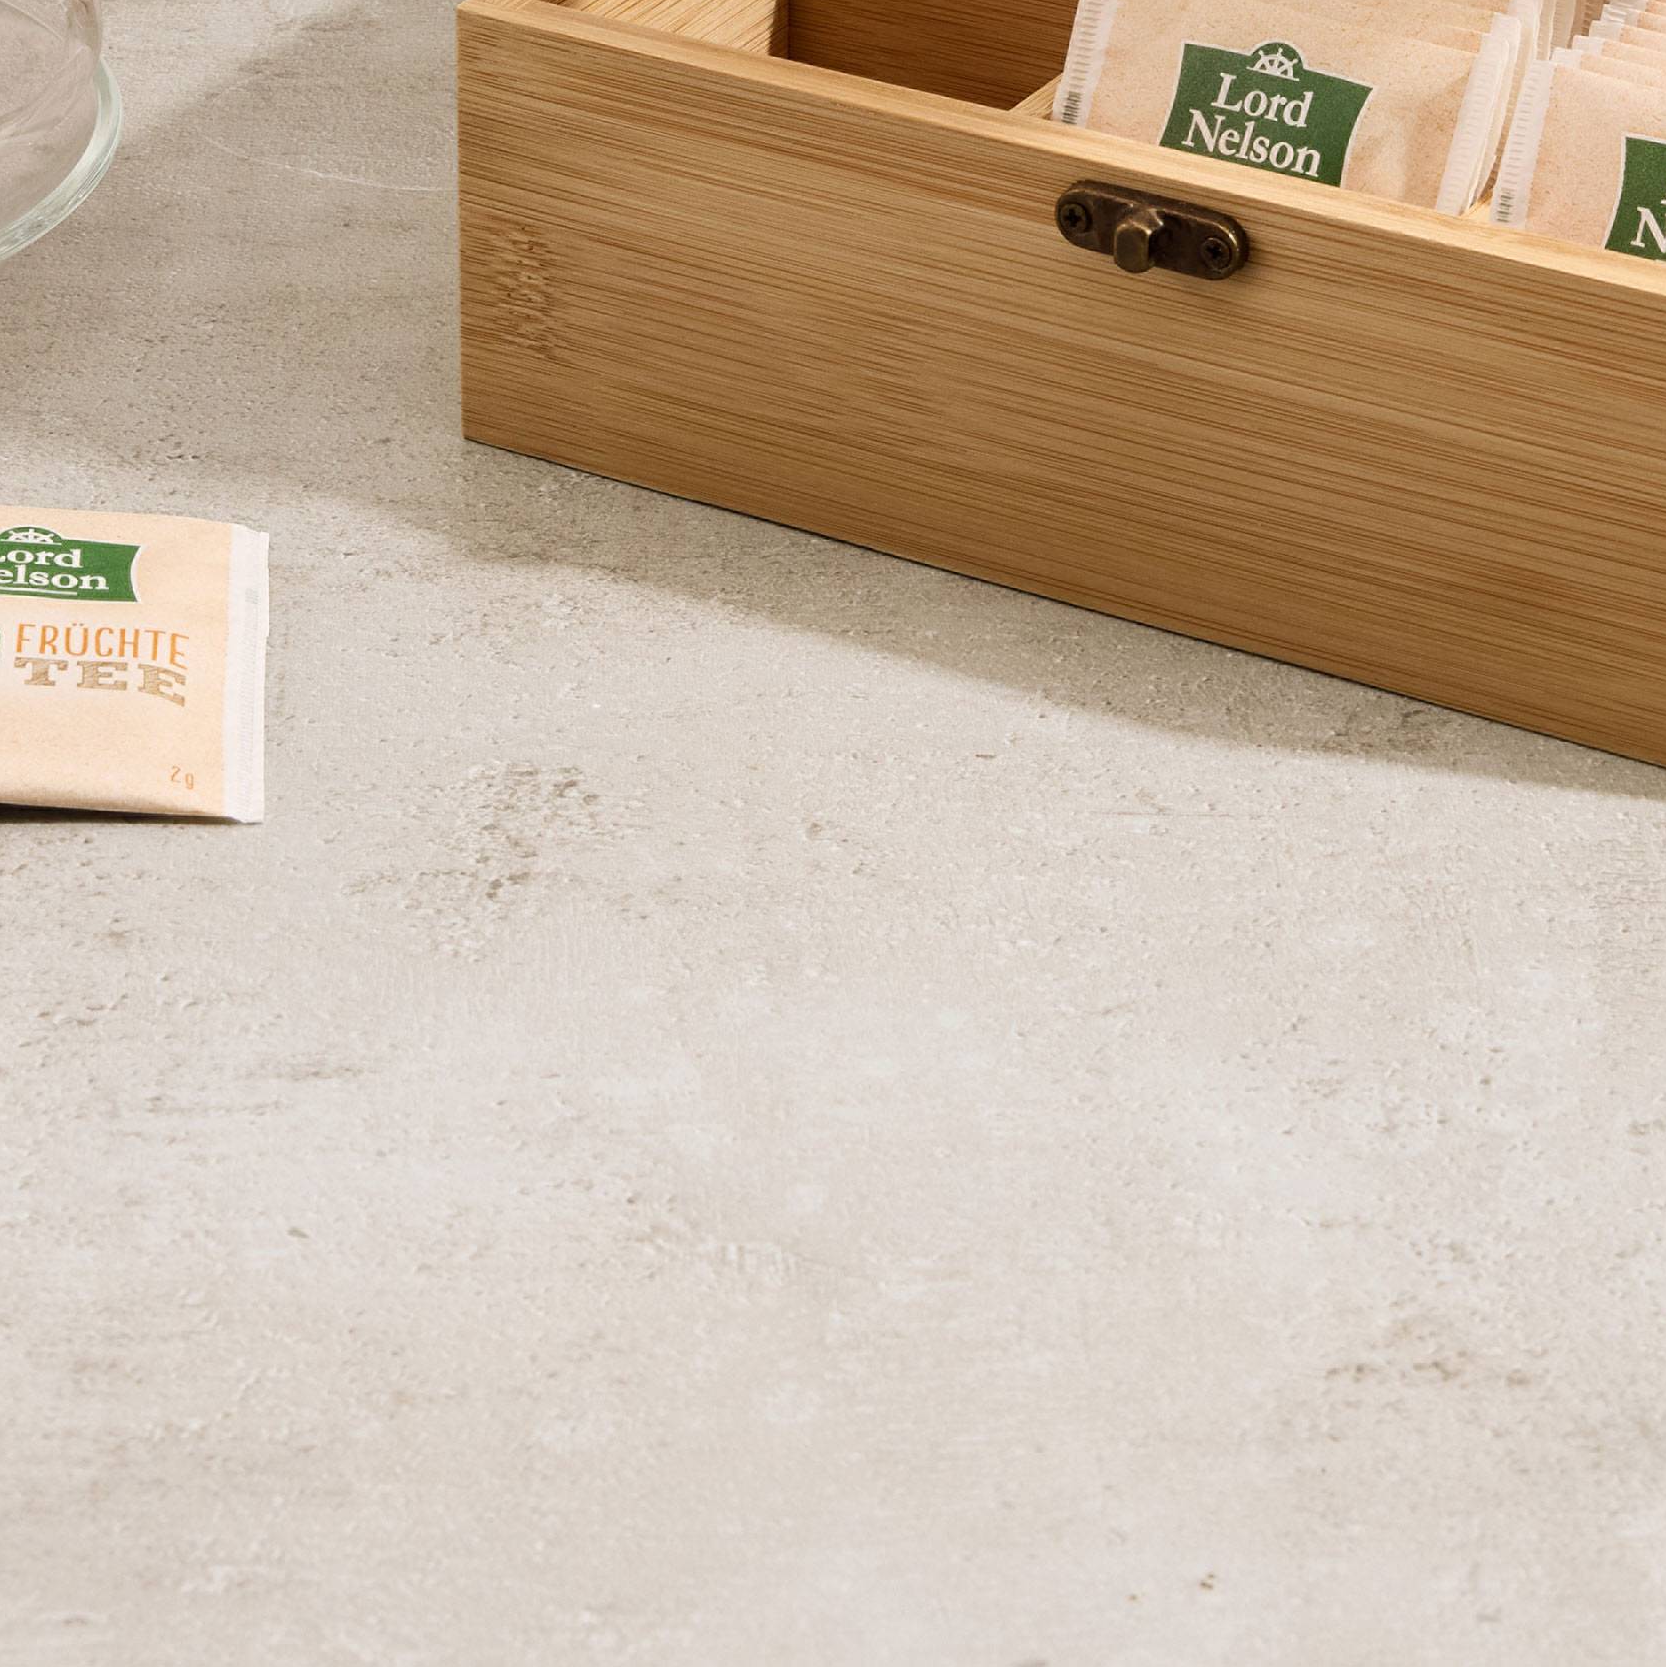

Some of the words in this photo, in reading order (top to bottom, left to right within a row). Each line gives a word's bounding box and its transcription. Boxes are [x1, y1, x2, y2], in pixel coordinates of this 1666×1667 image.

[1210, 73, 1314, 128] Lord
[1180, 109, 1321, 177] Nelson
[15, 622, 190, 668] FRÜCHTE
[14, 656, 187, 708] TEE
